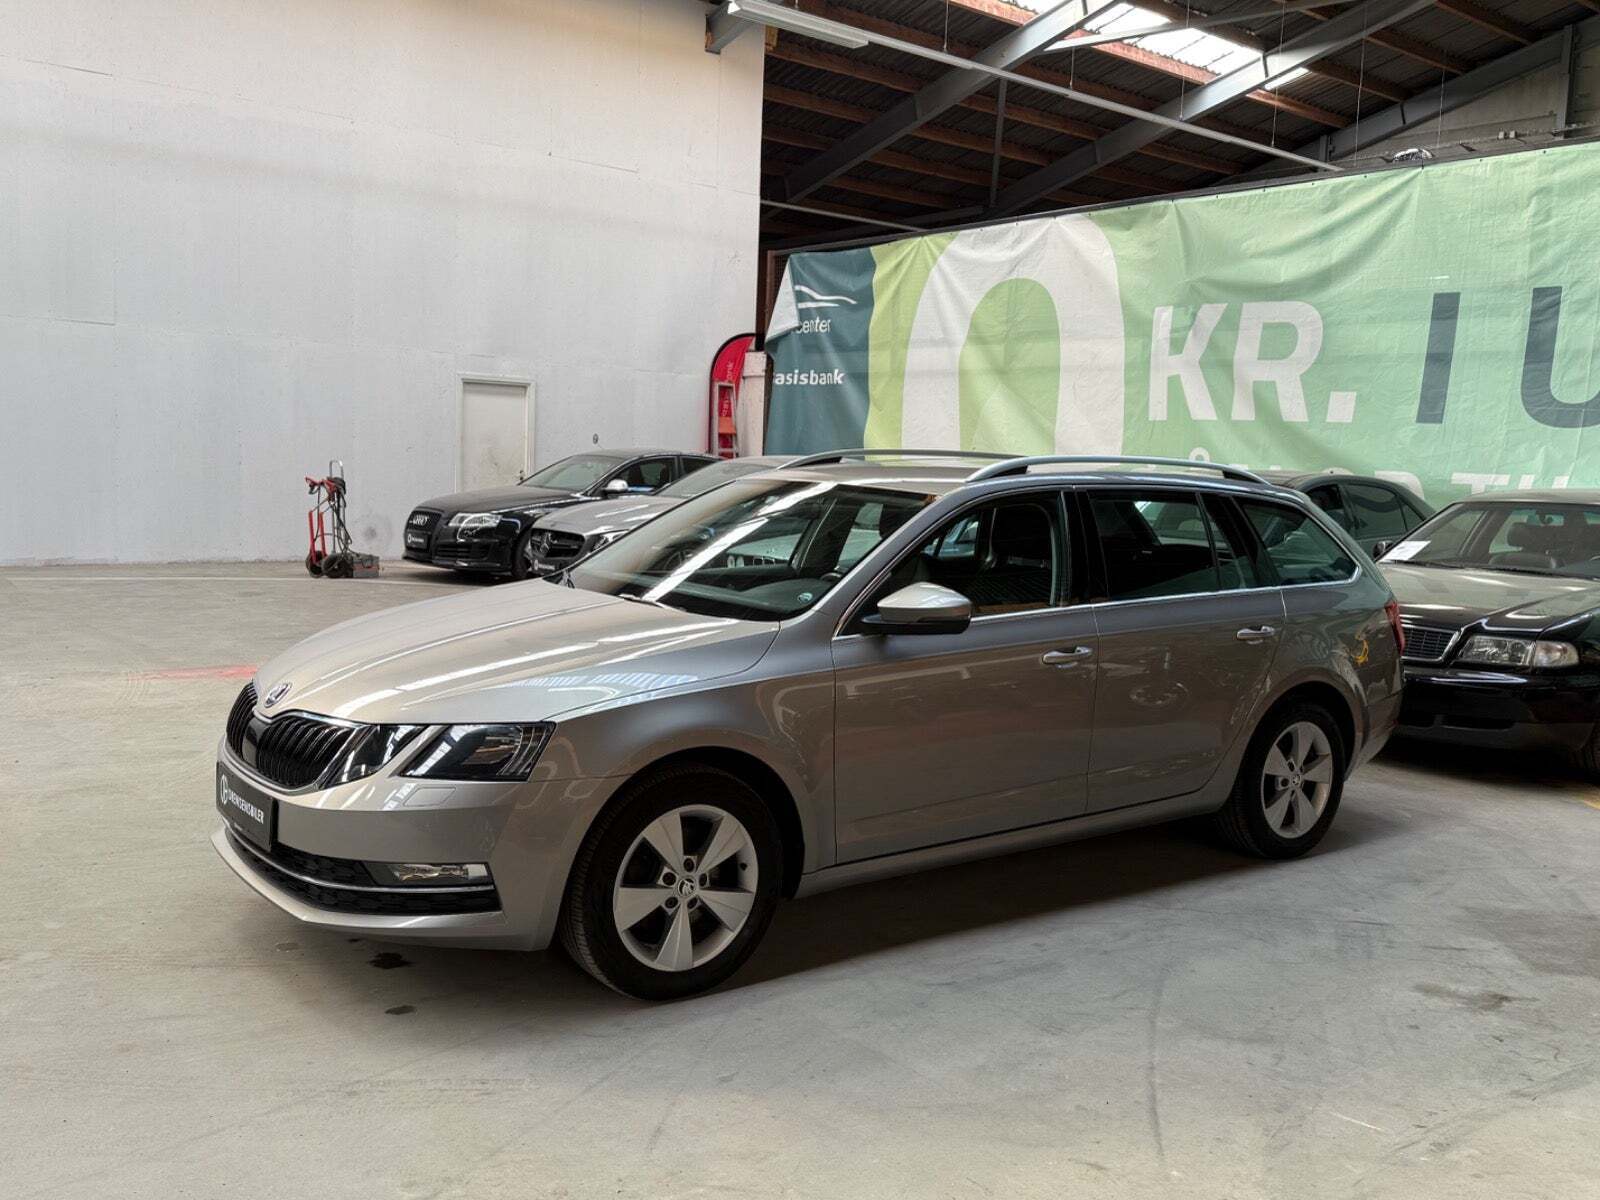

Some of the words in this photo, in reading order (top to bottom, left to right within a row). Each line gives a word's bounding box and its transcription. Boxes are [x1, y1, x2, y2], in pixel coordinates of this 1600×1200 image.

[773, 369, 845, 385] asisbank
[1148, 300, 1357, 423] KR.
[1415, 292, 1461, 424] I
